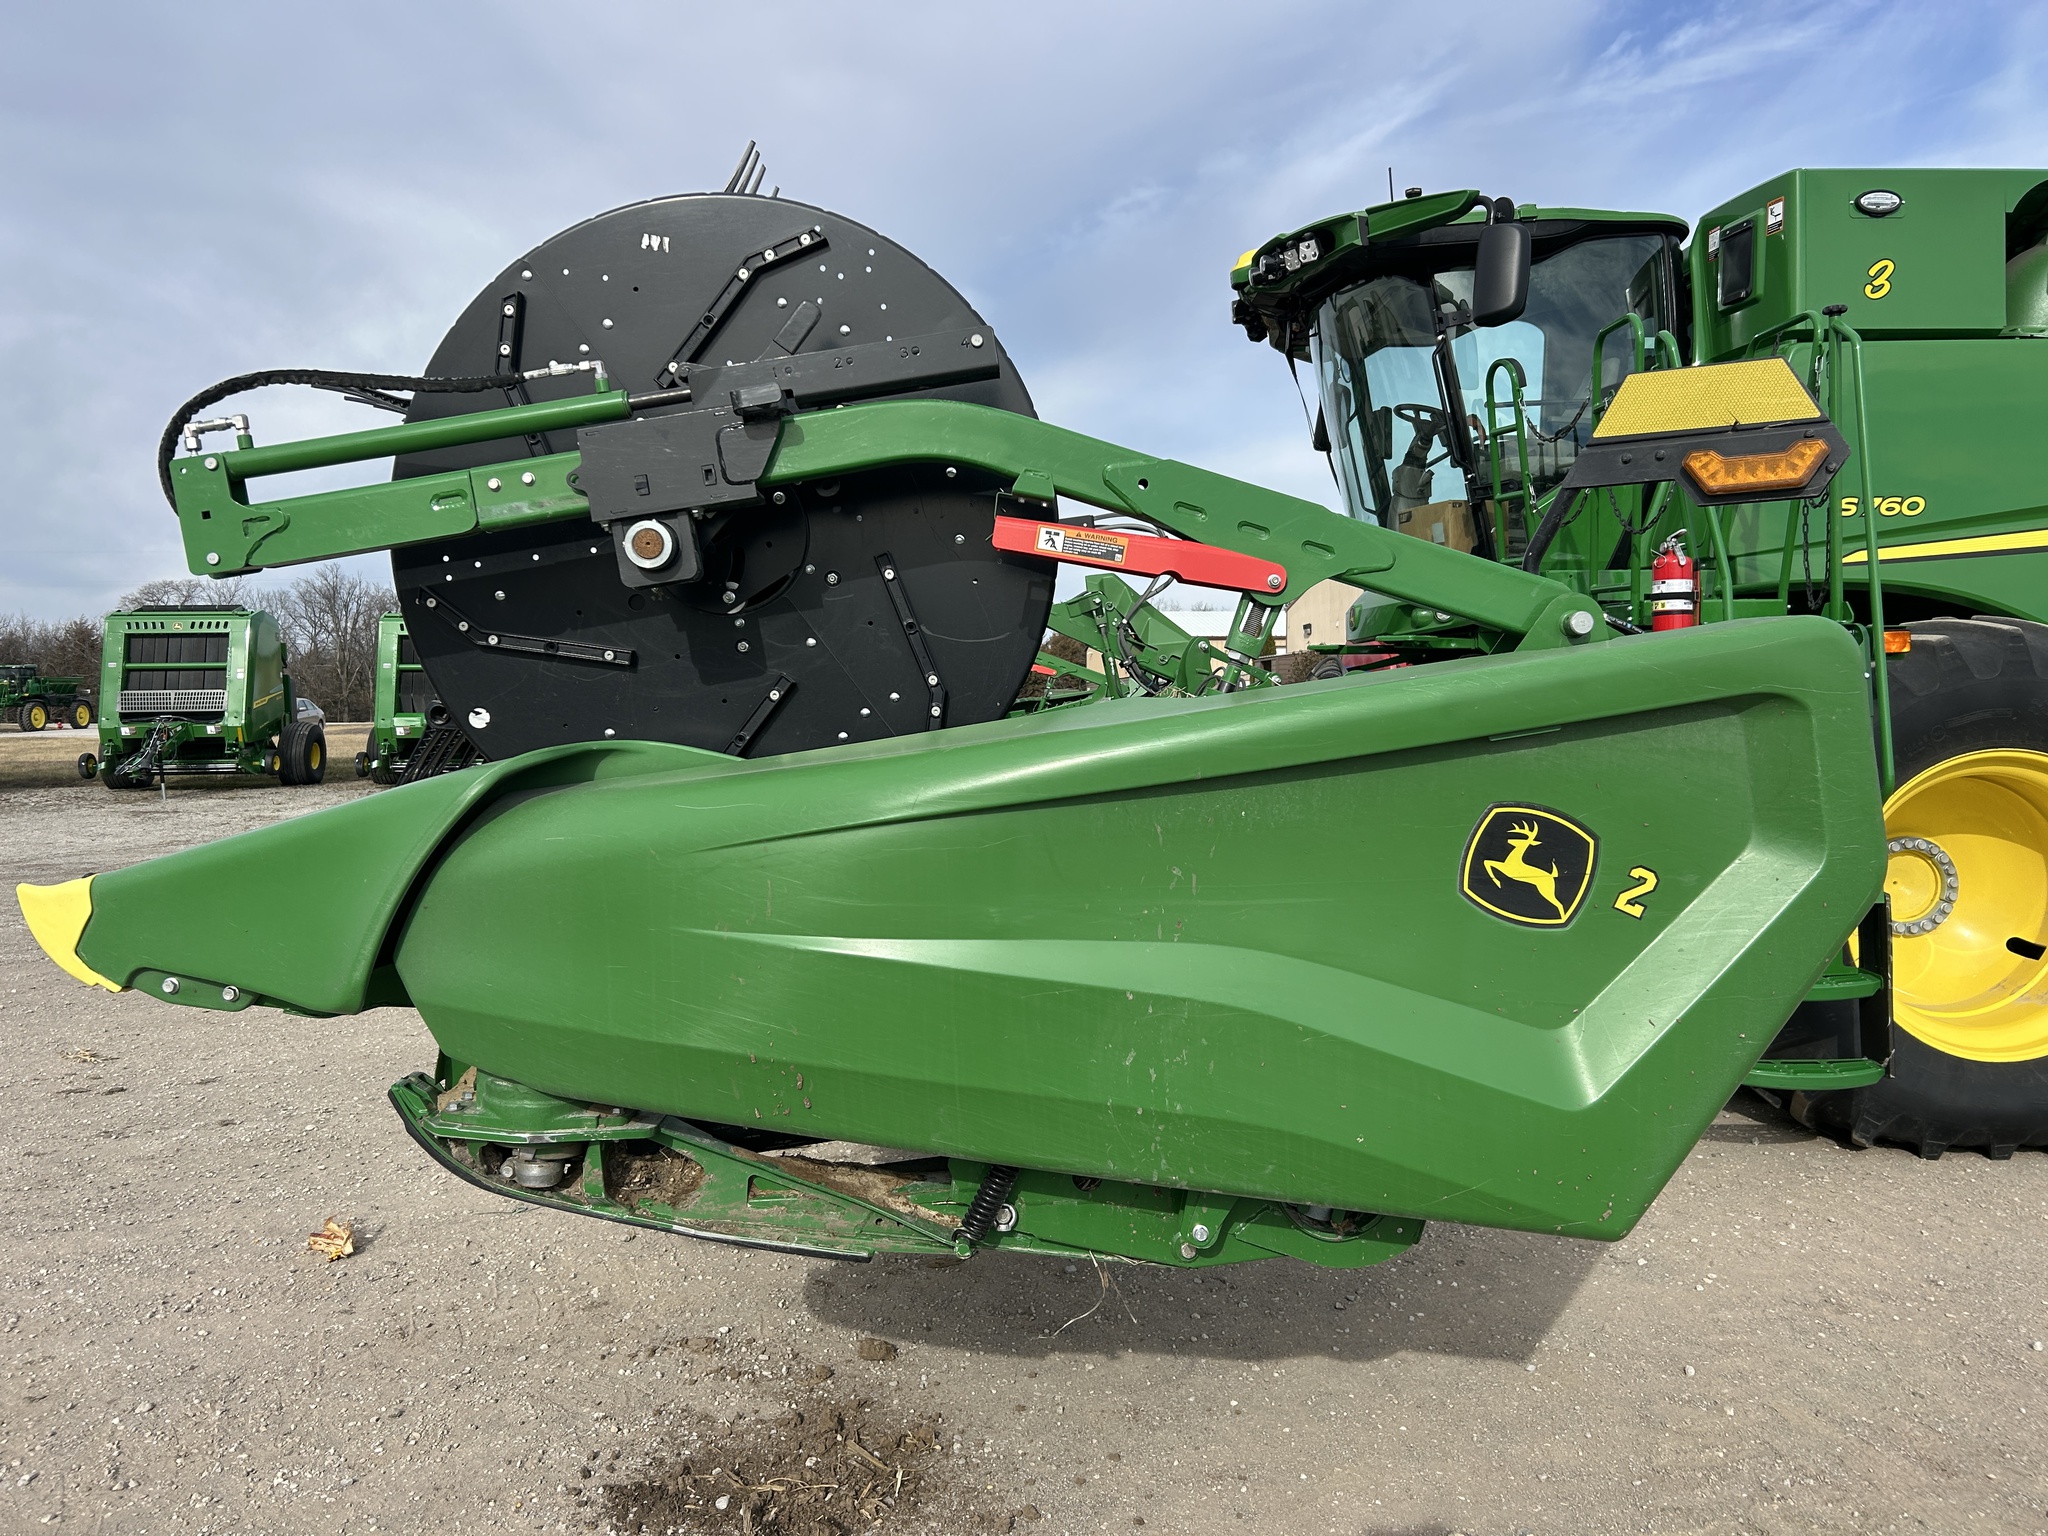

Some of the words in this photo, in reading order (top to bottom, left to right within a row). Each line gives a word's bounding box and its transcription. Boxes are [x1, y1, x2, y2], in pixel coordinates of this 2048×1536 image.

[1863, 258, 1896, 300] 3
[834, 356, 843, 369] 2
[900, 346, 909, 359] 3
[960, 336, 970, 349] 4
[1084, 532, 1118, 544] WARNING
[1612, 864, 1661, 921] 2
